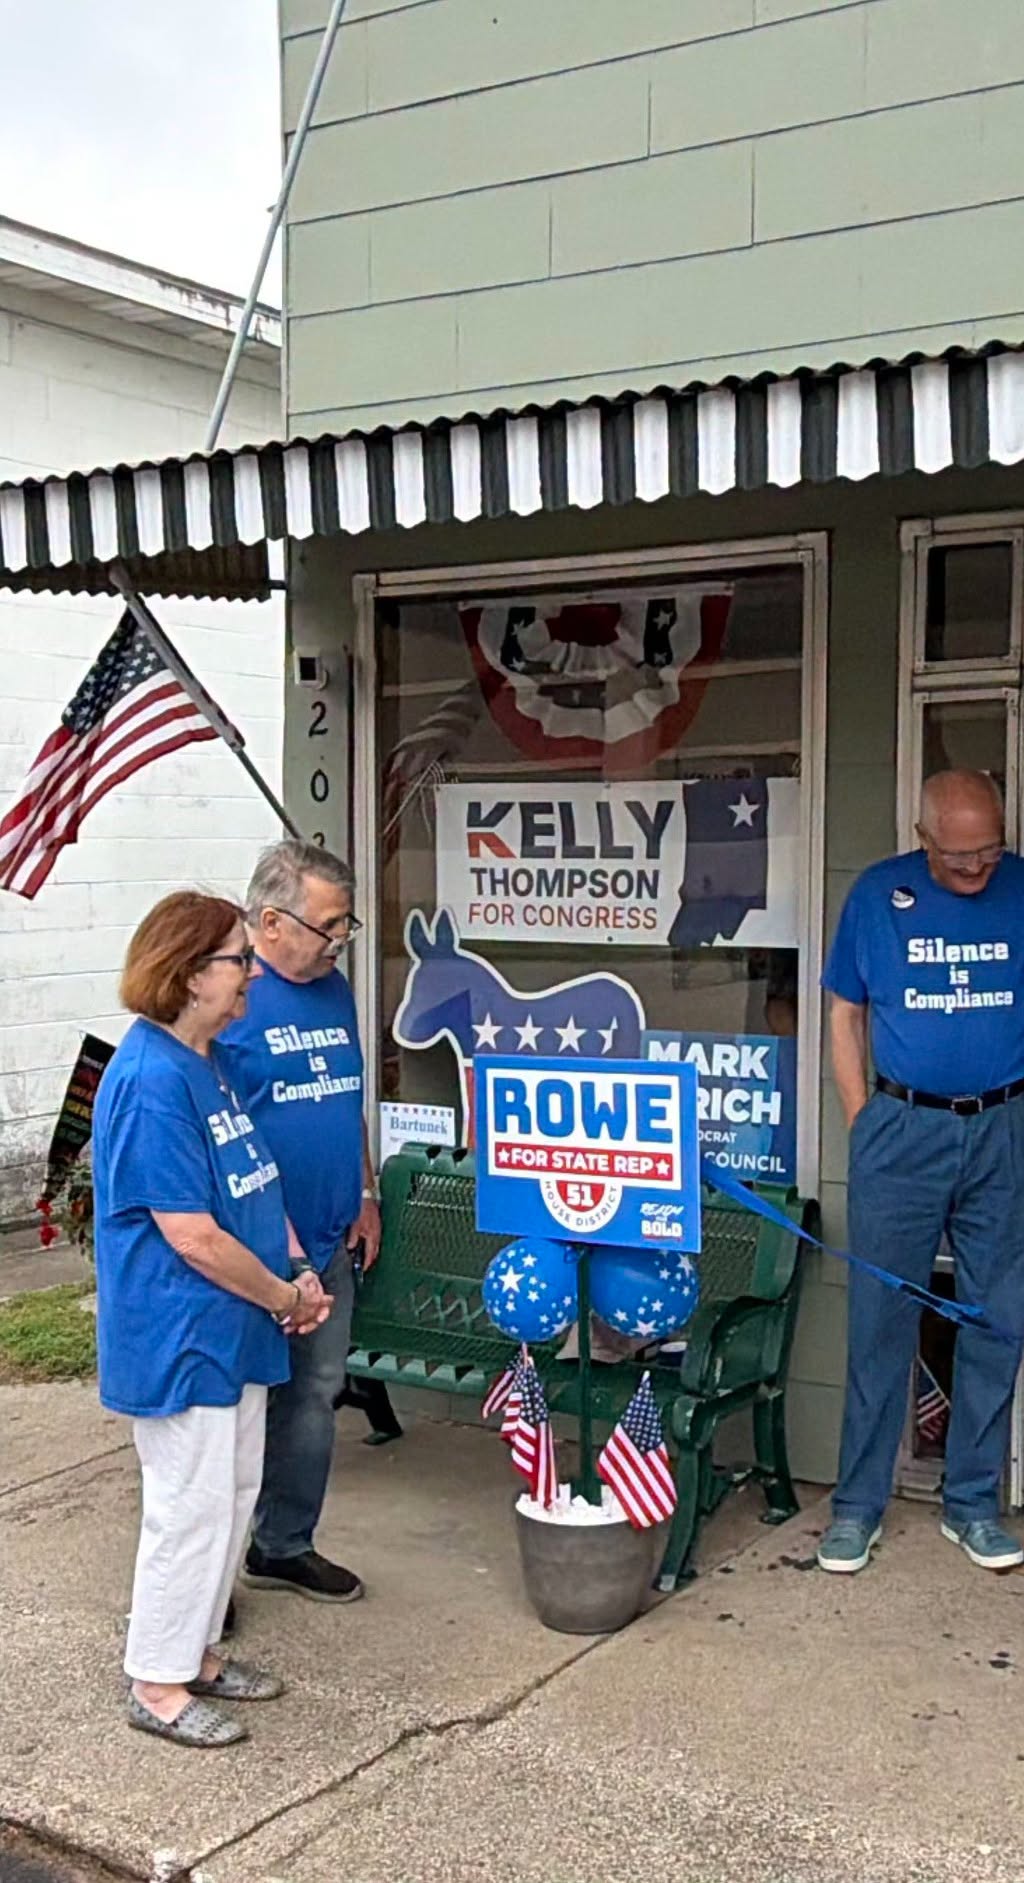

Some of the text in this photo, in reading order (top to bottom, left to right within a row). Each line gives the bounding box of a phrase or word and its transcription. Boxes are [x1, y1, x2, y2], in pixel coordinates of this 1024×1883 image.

[467, 801, 675, 859] KELLY
[470, 867, 660, 899] THOMPSON
[468, 903, 657, 929] FOR CONGRESS
[907, 937, 1009, 963] Silence
[949, 964, 970, 985] is
[904, 988, 1014, 1014] Compliance
[264, 1024, 350, 1055] Silence
[307, 1052, 327, 1073] is
[649, 1041, 770, 1079] MARK
[493, 1077, 673, 1144] ROWE
[698, 1087, 781, 1125] RICH
[390, 1116, 448, 1135] Bartunek
[698, 1130, 738, 1143] OCRAT
[511, 1147, 654, 1175] FOR STATE REP
[545, 1181, 617, 1227] HOUSE DISTRICT
[565, 1184, 595, 1207] 51
[641, 1220, 683, 1237] BOLD
